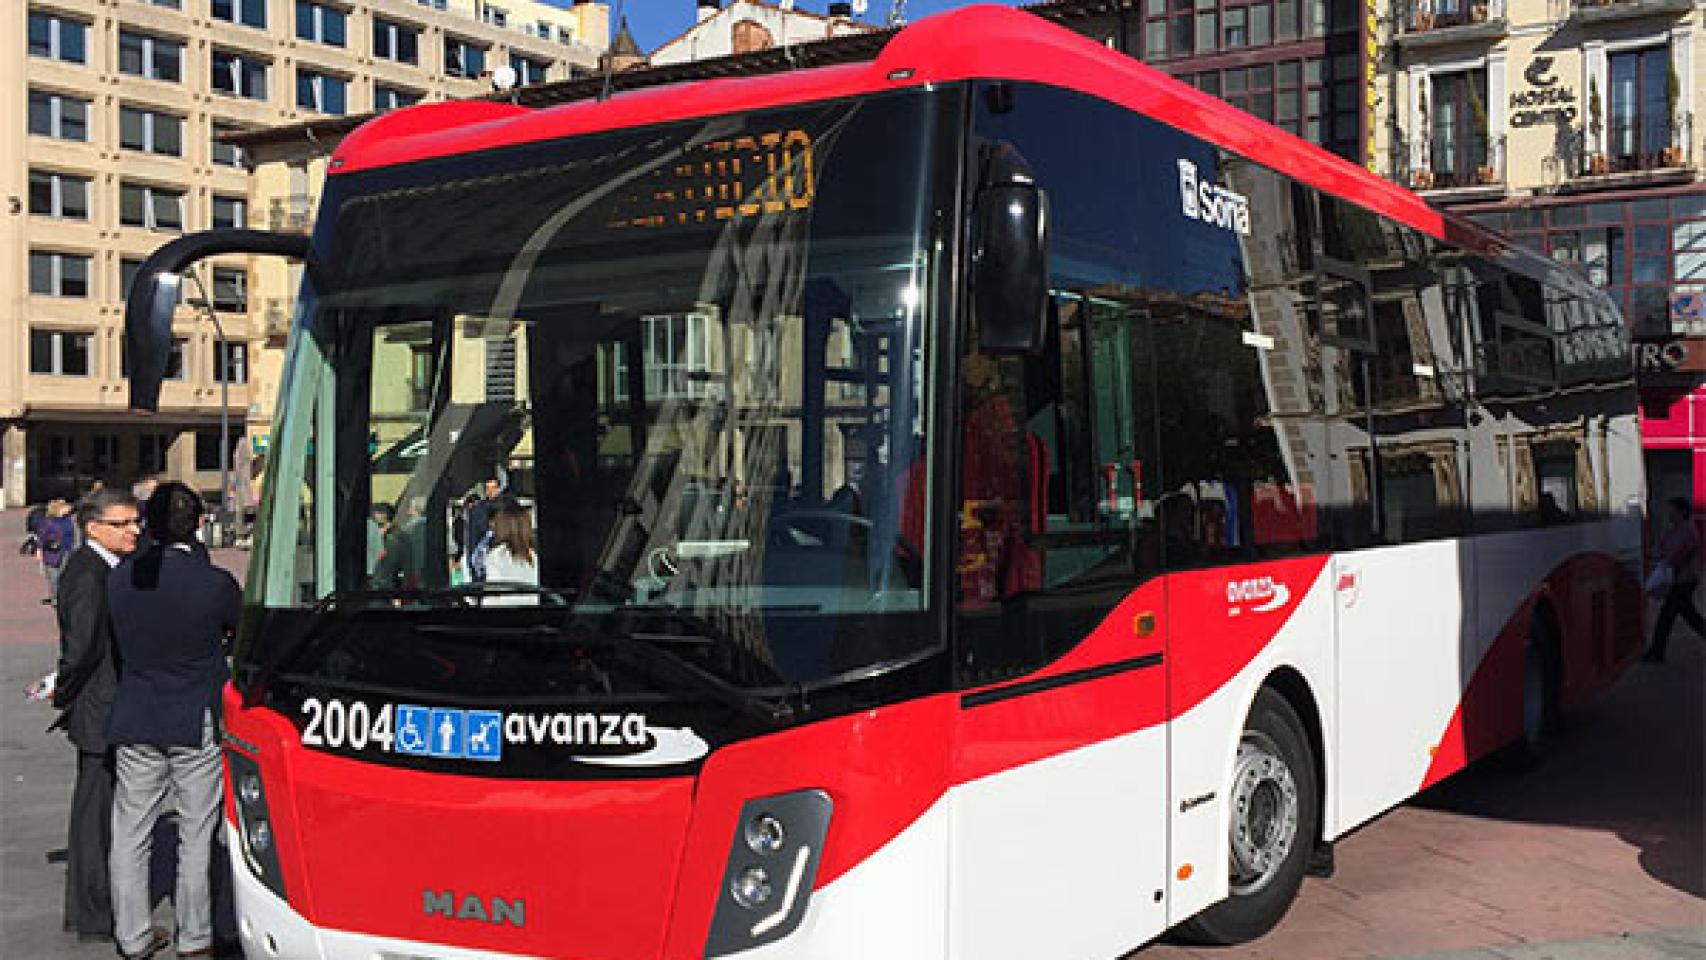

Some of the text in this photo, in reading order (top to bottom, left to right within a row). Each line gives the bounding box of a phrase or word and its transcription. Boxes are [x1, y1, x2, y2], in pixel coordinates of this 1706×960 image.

[1509, 87, 1577, 108] HOSTAL
[1509, 107, 1577, 128] CENTRO
[301, 698, 393, 751] 2004
[504, 712, 647, 745] avanza
[422, 888, 525, 927] MAN
